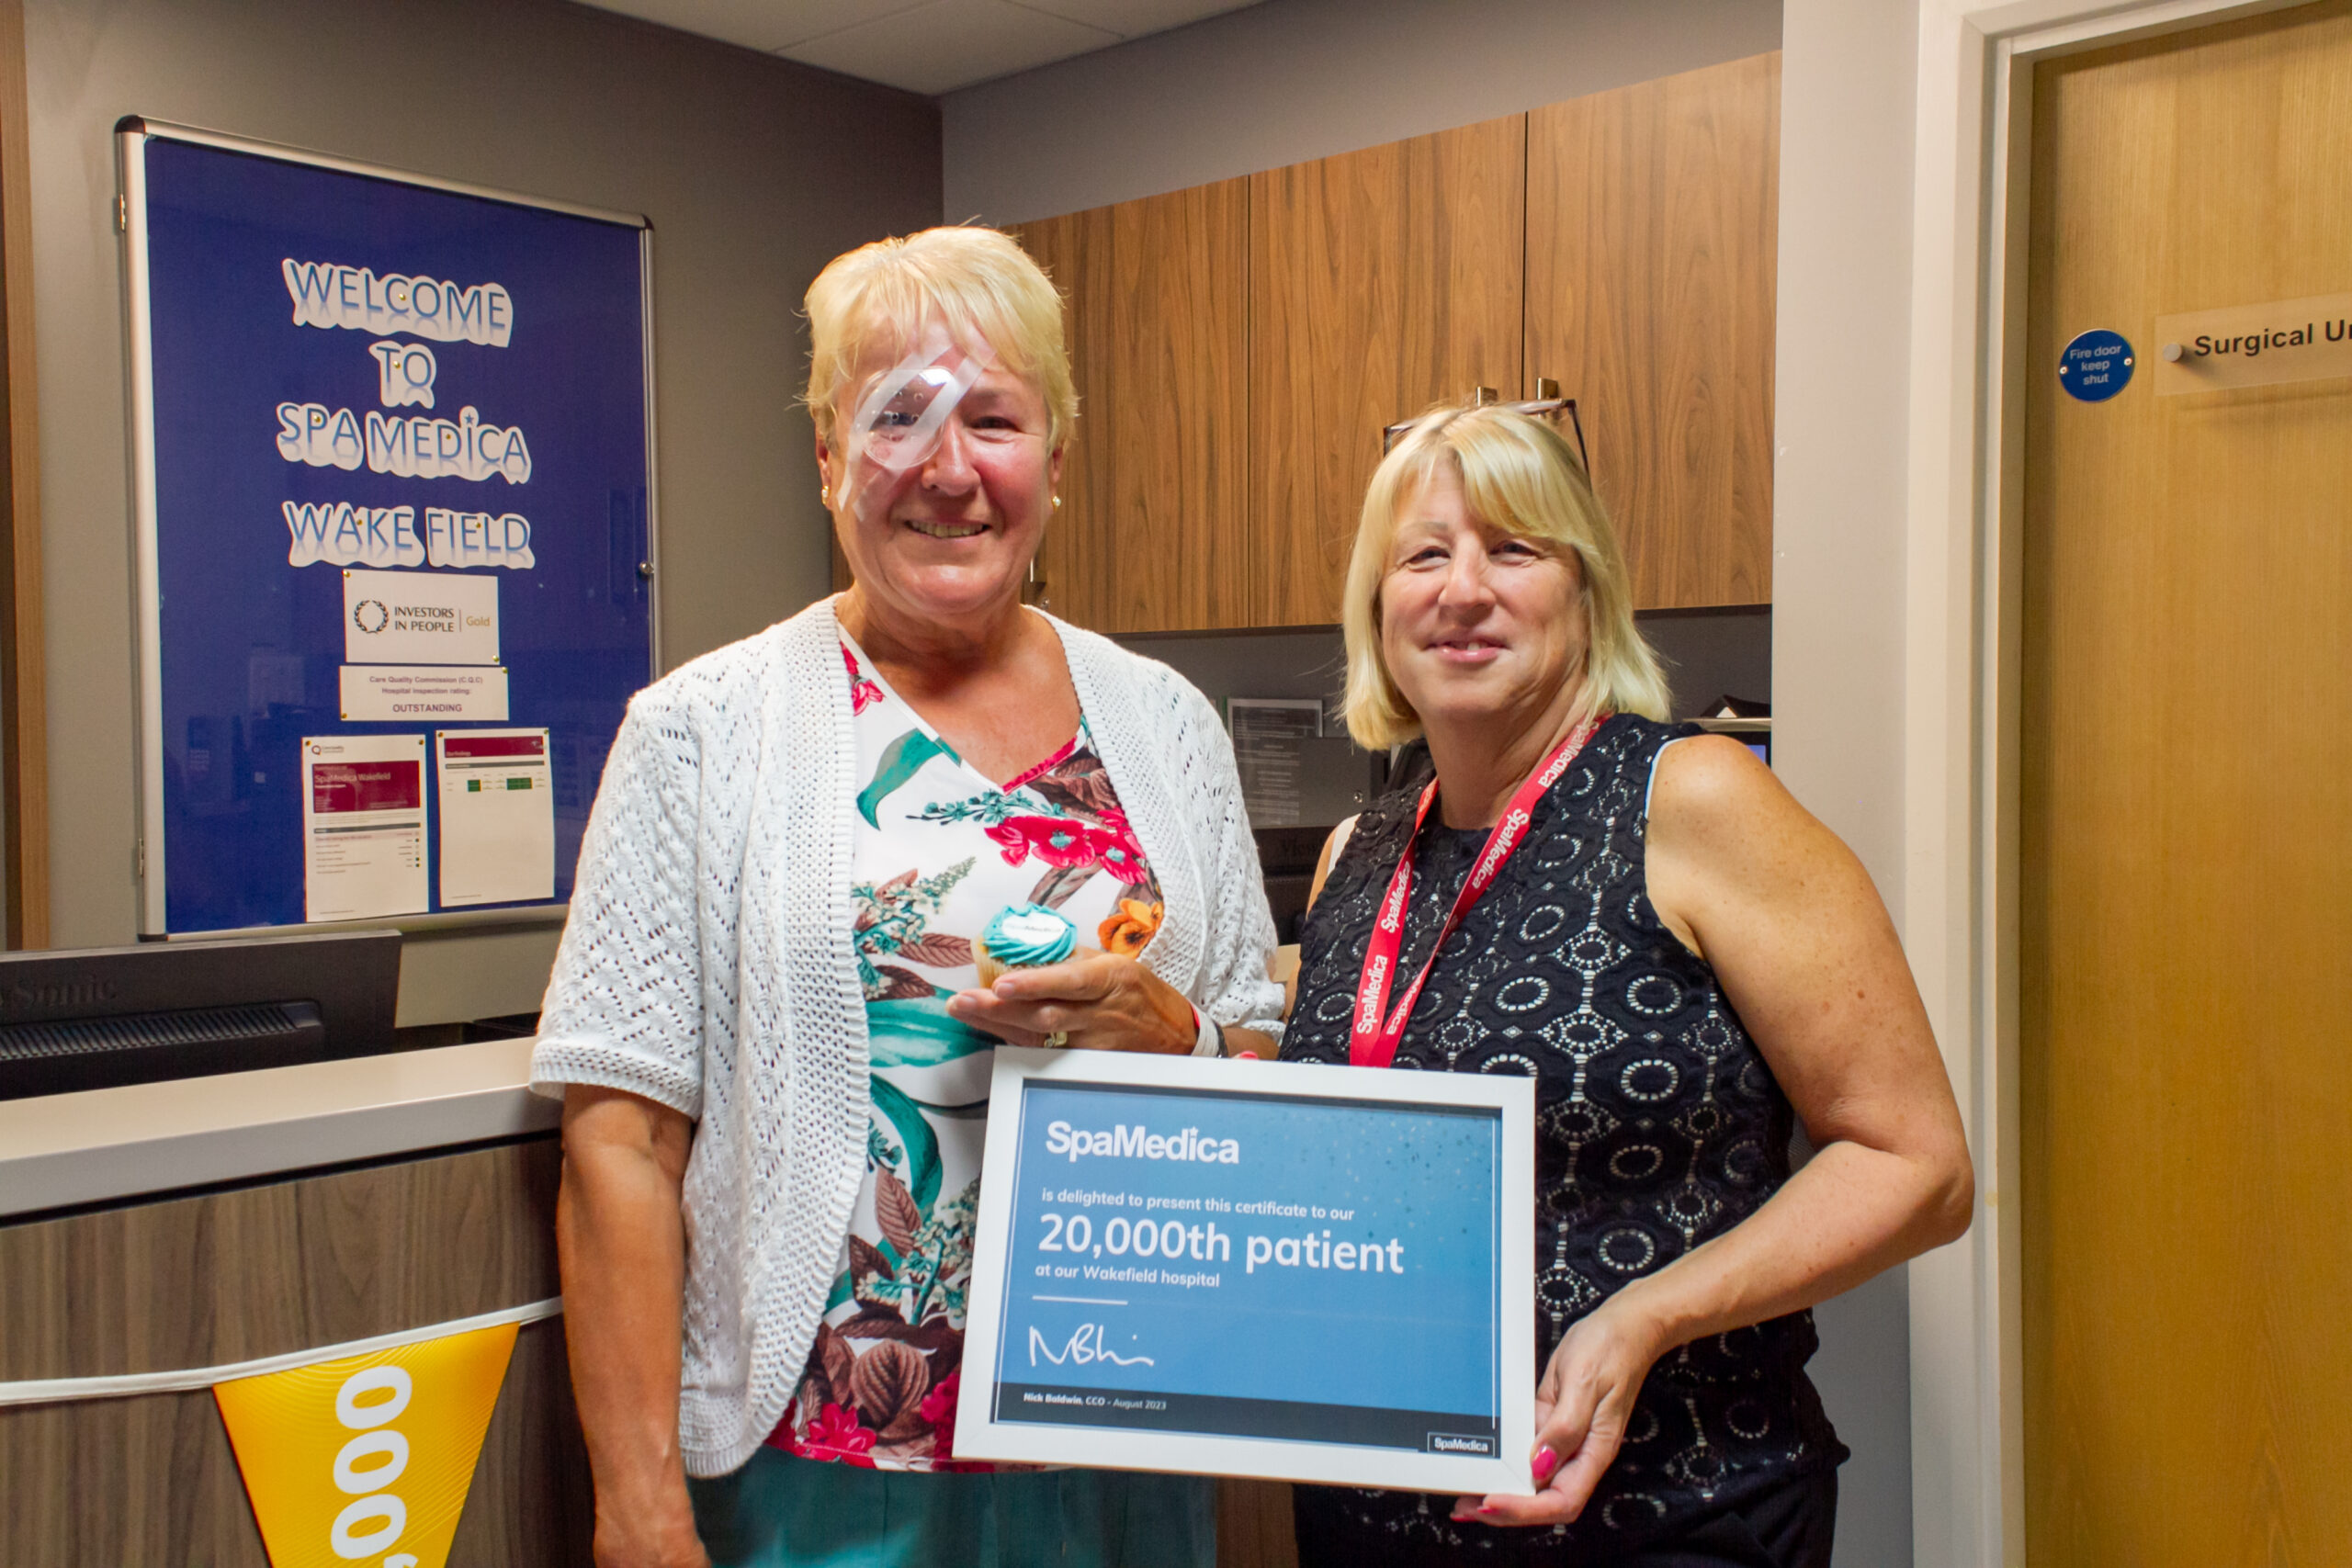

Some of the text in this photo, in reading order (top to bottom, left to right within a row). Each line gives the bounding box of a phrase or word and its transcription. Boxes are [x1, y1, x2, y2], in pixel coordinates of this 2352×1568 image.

[290, 263, 505, 329] WELCOME
[2195, 323, 2312, 356] Surgical
[2070, 345, 2121, 360] Fire door
[376, 345, 432, 387] TO
[2081, 360, 2110, 372] keep
[2083, 373, 2109, 385] shut
[369, 412, 527, 467] MEDICA
[394, 606, 455, 618] INVESTORS
[466, 615, 491, 626] Gold
[394, 621, 455, 632] IN PEOPLE
[382, 687, 411, 695] Hospital
[388, 676, 413, 684] Quality
[392, 704, 463, 713] OUTSTANDING
[1472, 808, 1529, 889] SpaMedica
[1381, 861, 1411, 933] SpaMedica
[1356, 954, 1388, 1034] SpaMedica
[1046, 1121, 1239, 1164] SpaMedica
[1042, 1188, 1355, 1220] is delighted to present this certificate to our
[1038, 1213, 1405, 1274] 20,000th patient
[1035, 1264, 1220, 1289] at our Wakefield hospital
[1023, 1392, 1044, 1403] Nick
[1085, 1396, 1105, 1406] CCO
[1113, 1398, 1143, 1411] August
[1145, 1400, 1167, 1411] 2023
[1434, 1437, 1488, 1452] SpaMedica
